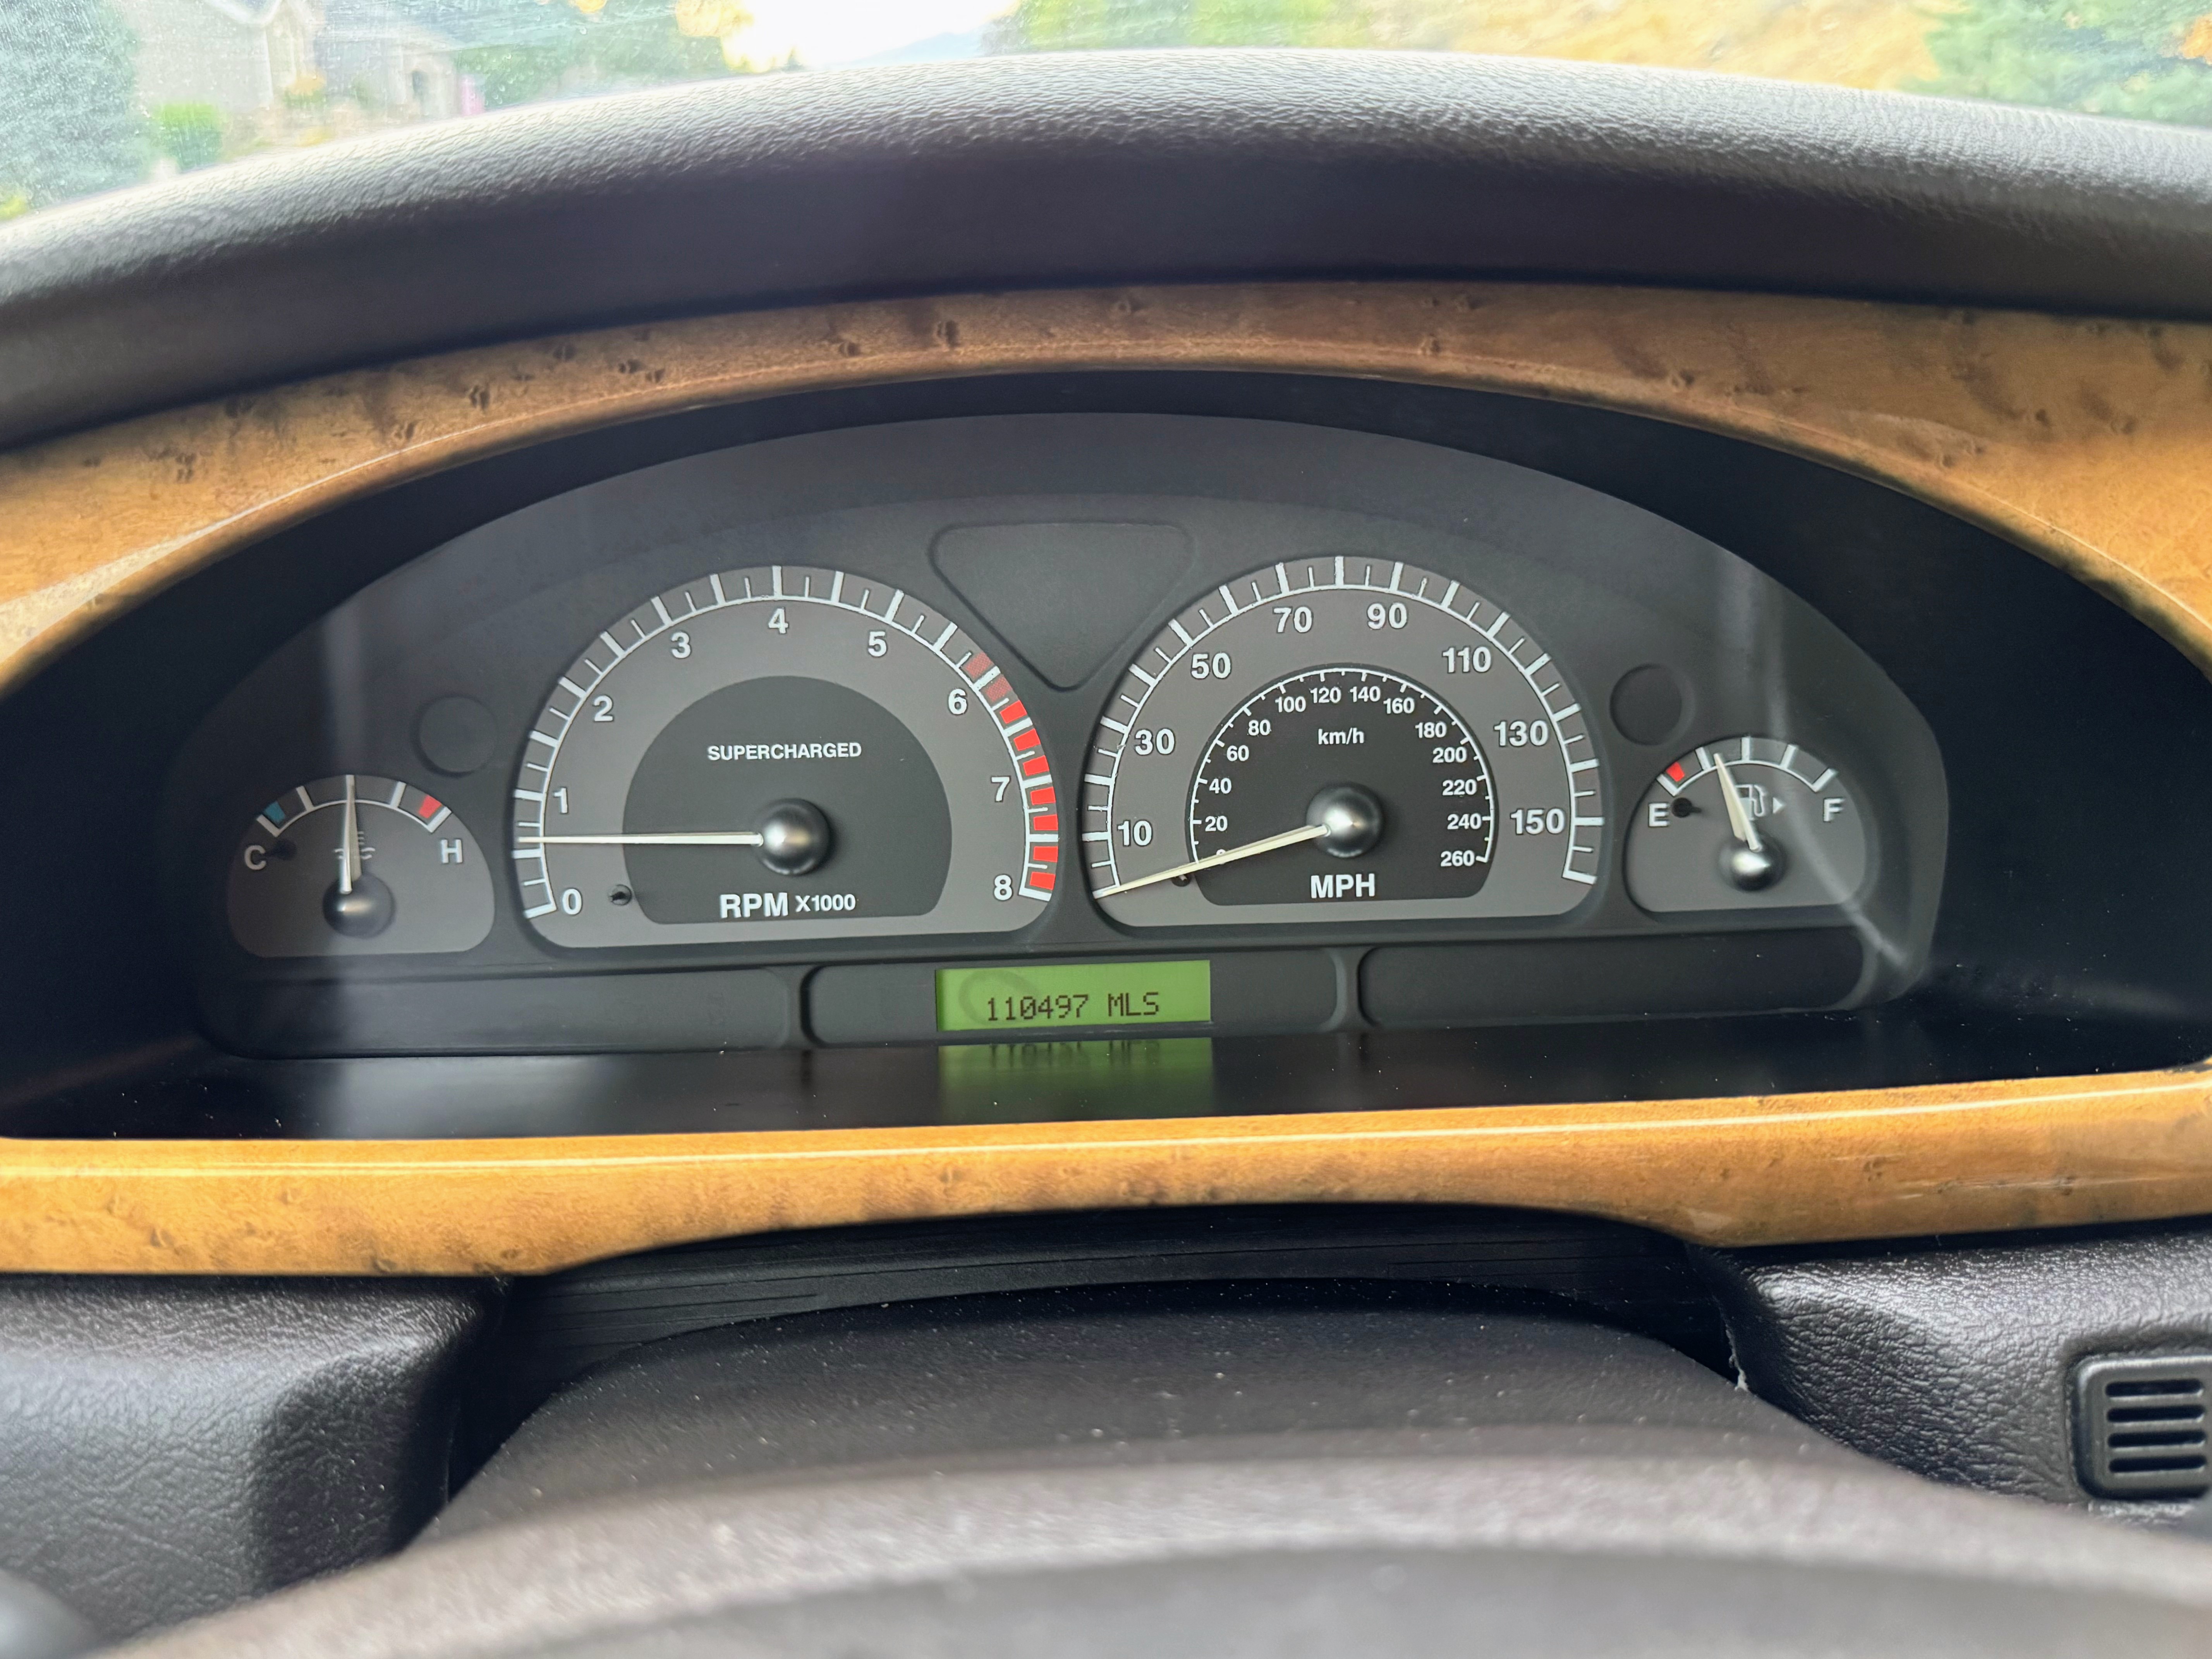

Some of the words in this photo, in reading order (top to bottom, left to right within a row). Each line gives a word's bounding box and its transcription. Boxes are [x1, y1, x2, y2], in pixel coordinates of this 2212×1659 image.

[768, 608, 789, 634] 4
[1273, 606, 1312, 633] 70
[1367, 602, 1407, 630] 90
[671, 632, 691, 659] 3
[868, 631, 887, 657] 5
[1191, 652, 1231, 679] 50
[1442, 646, 1491, 673] 110
[948, 688, 967, 715] 6
[1274, 696, 1307, 713] 100
[1310, 686, 1342, 704] 120
[1349, 685, 1381, 703] 140
[1383, 697, 1415, 714] 160
[593, 695, 613, 722] 2
[1248, 719, 1272, 736] 80
[1318, 727, 1364, 745] km/h
[1415, 721, 1447, 738] 180
[1494, 720, 1548, 747] 130
[707, 742, 862, 761] SUPERCHARGED
[1135, 728, 1175, 755] 30
[1226, 744, 1250, 762] 60
[1432, 746, 1467, 763] 200
[991, 776, 1010, 802] 7
[1209, 777, 1232, 794] 40
[1442, 778, 1477, 796] 220
[553, 787, 568, 814] 1
[1823, 798, 1844, 822] F
[1205, 815, 1228, 832] 20
[1447, 812, 1482, 830] 240
[1510, 808, 1565, 835] 150
[1649, 802, 1669, 827] E
[1117, 820, 1152, 846] 10
[244, 845, 266, 871] C
[440, 839, 463, 864] H
[1440, 850, 1475, 867] 260
[994, 874, 1013, 901] 8
[1310, 873, 1375, 899] MPH
[562, 888, 582, 915] 0
[720, 892, 788, 919] RPM
[795, 893, 856, 913] X1000
[988, 994, 1089, 1022] 110497
[1108, 991, 1159, 1017] MLS
